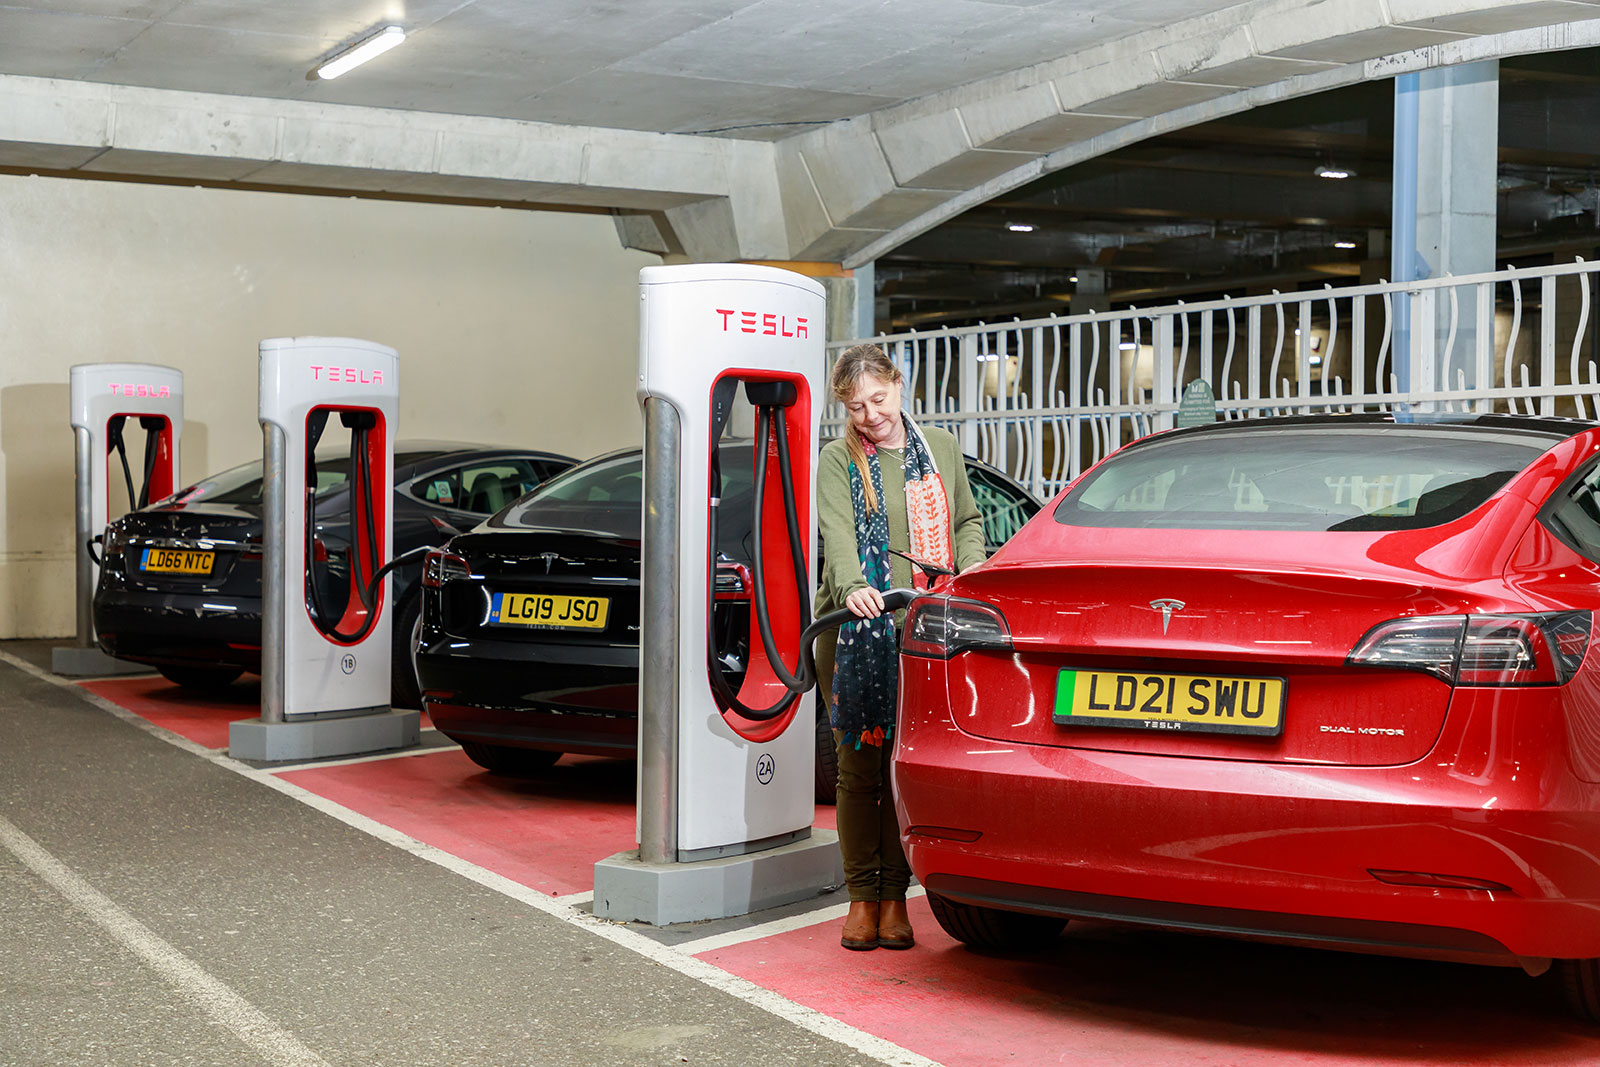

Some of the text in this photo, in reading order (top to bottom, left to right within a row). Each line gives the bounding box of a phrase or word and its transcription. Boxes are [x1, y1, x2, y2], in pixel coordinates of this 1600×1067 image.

[716, 309, 808, 339] TESLA
[310, 366, 383, 384] TESLA
[108, 383, 170, 398] TESLA
[148, 551, 211, 570] LD66 NTC
[508, 596, 599, 622] LG19 JSO
[344, 659, 353, 668] 1B
[1088, 674, 1267, 718] LD21 SWU
[1144, 720, 1181, 729] TESLA
[1320, 725, 1404, 736] DUAL MOTOR
[759, 761, 772, 775] 2A
